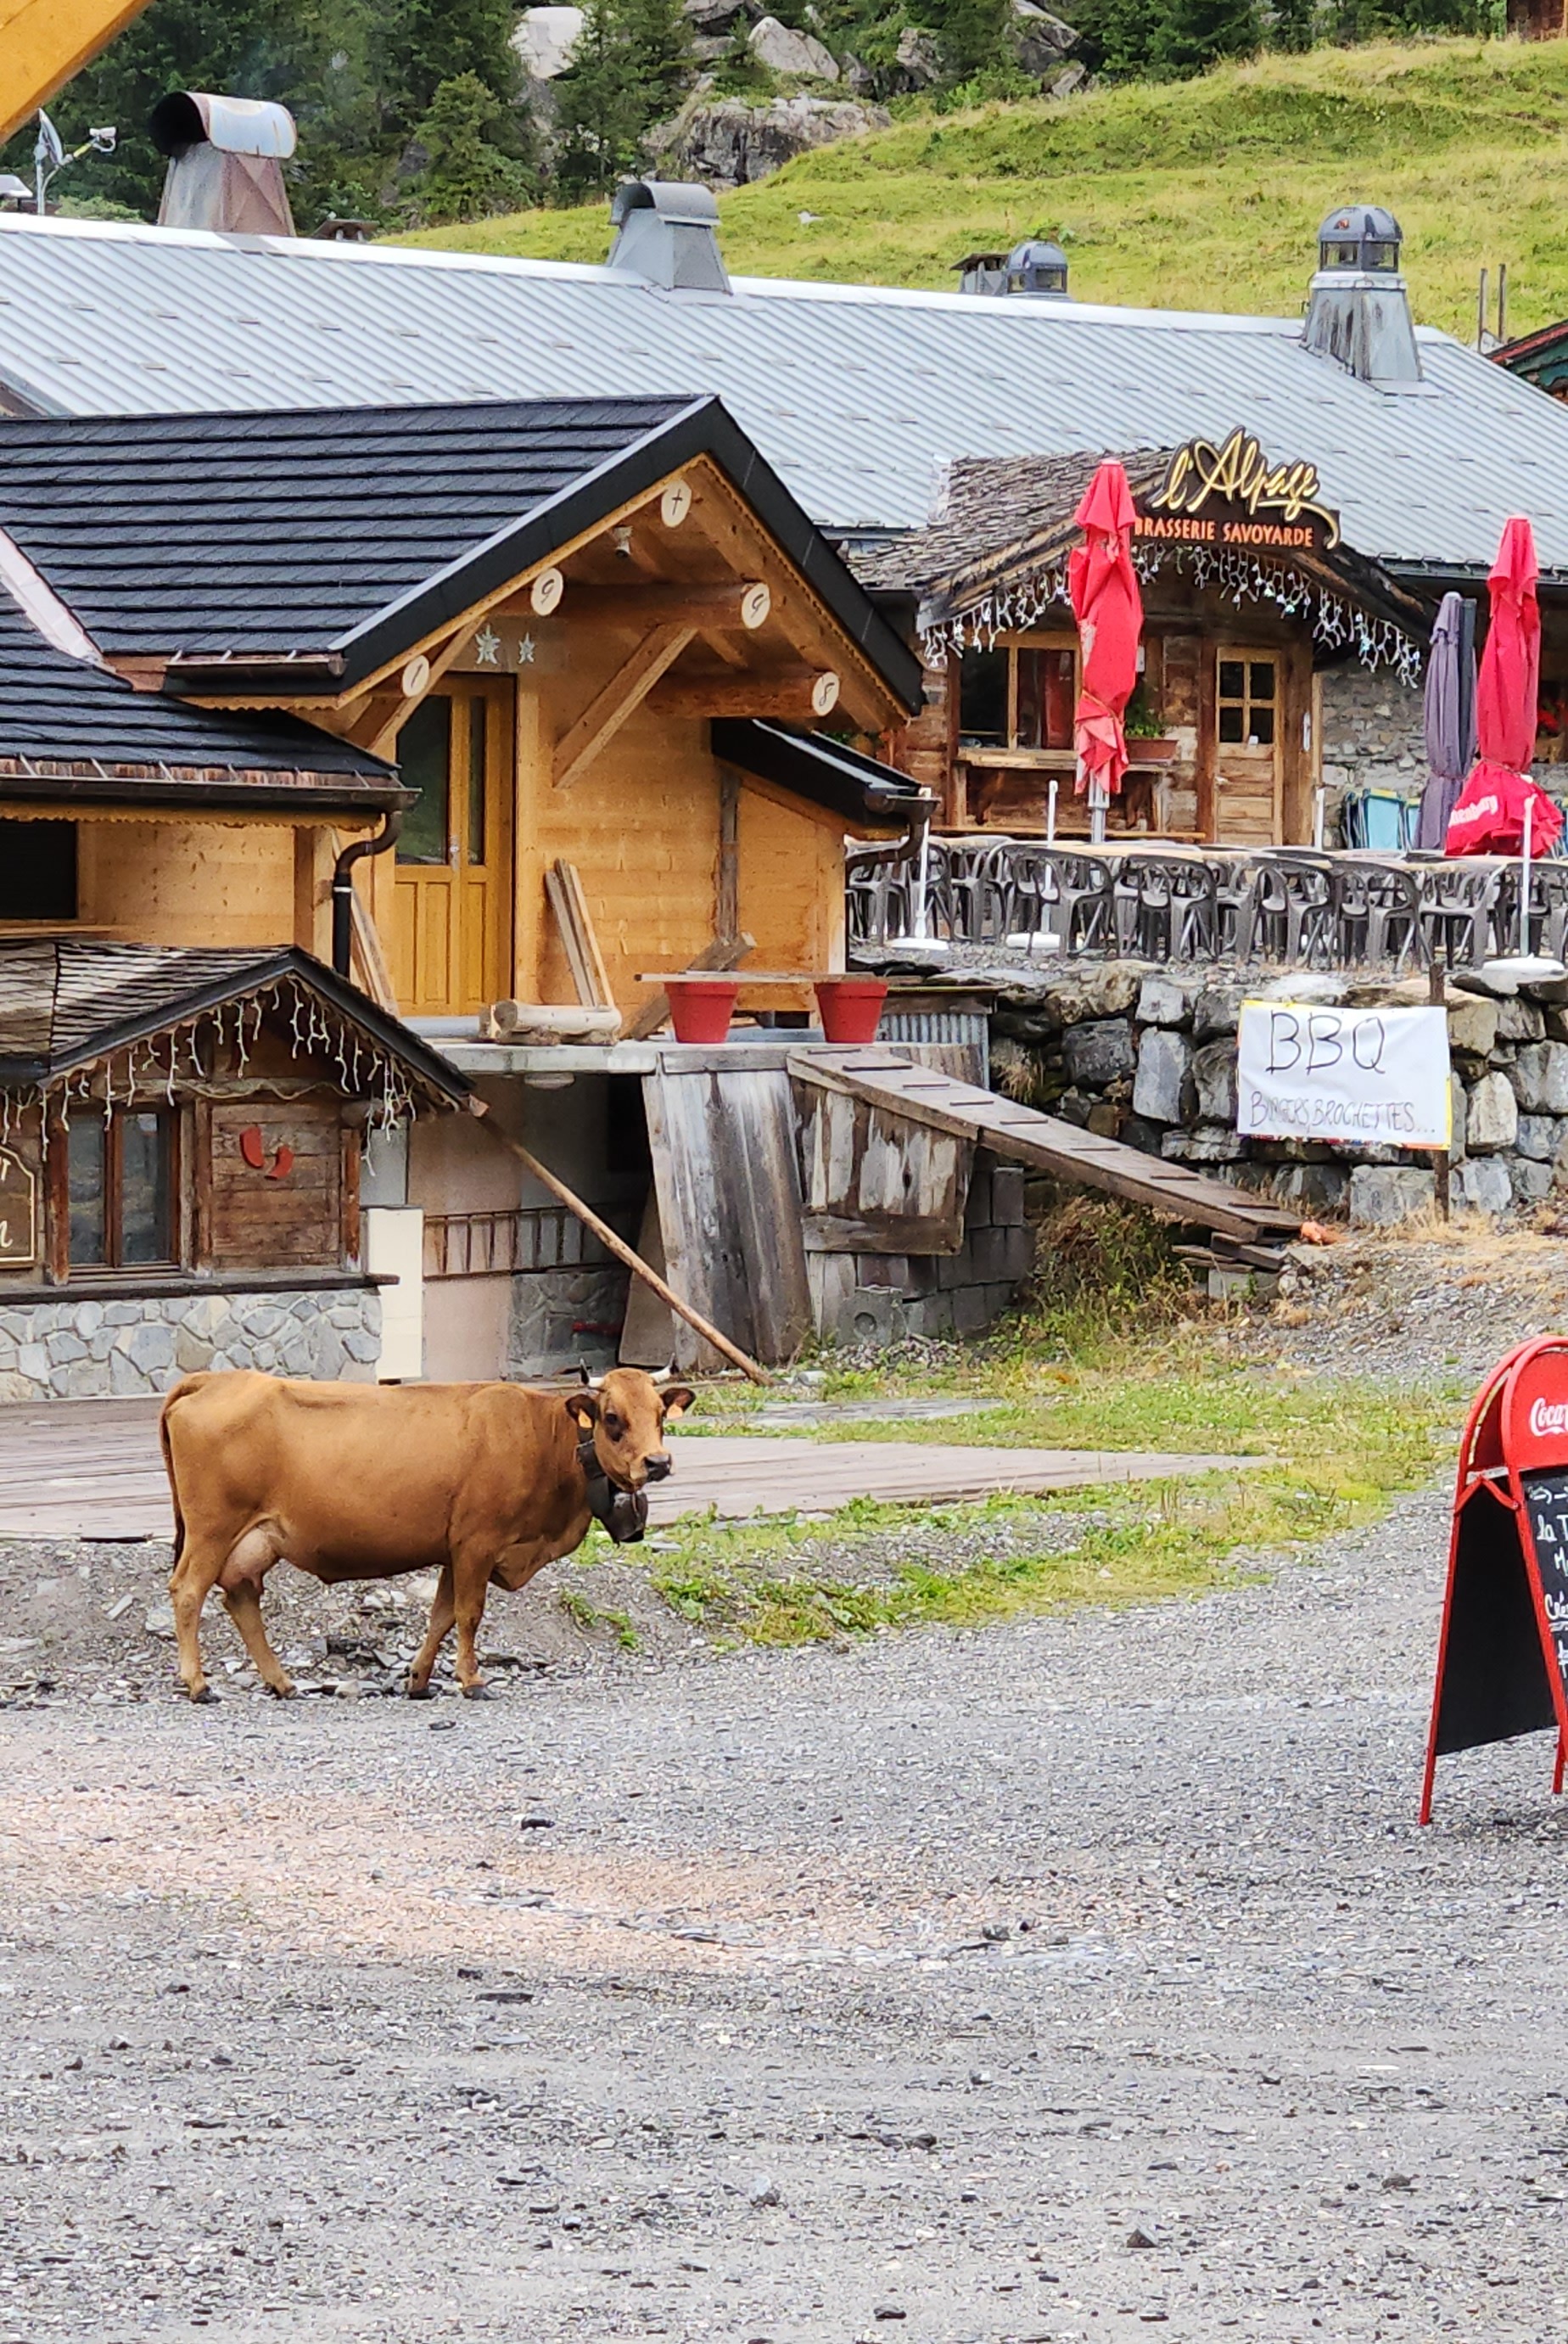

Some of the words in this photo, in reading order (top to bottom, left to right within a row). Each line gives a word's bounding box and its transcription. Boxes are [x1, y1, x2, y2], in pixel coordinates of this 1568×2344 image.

[1134, 515, 1217, 541] BRASSERIE
[1223, 521, 1314, 548] SAVOYARDE
[1265, 1009, 1386, 1075] BBQ
[1530, 1396, 1568, 1437] Coca
